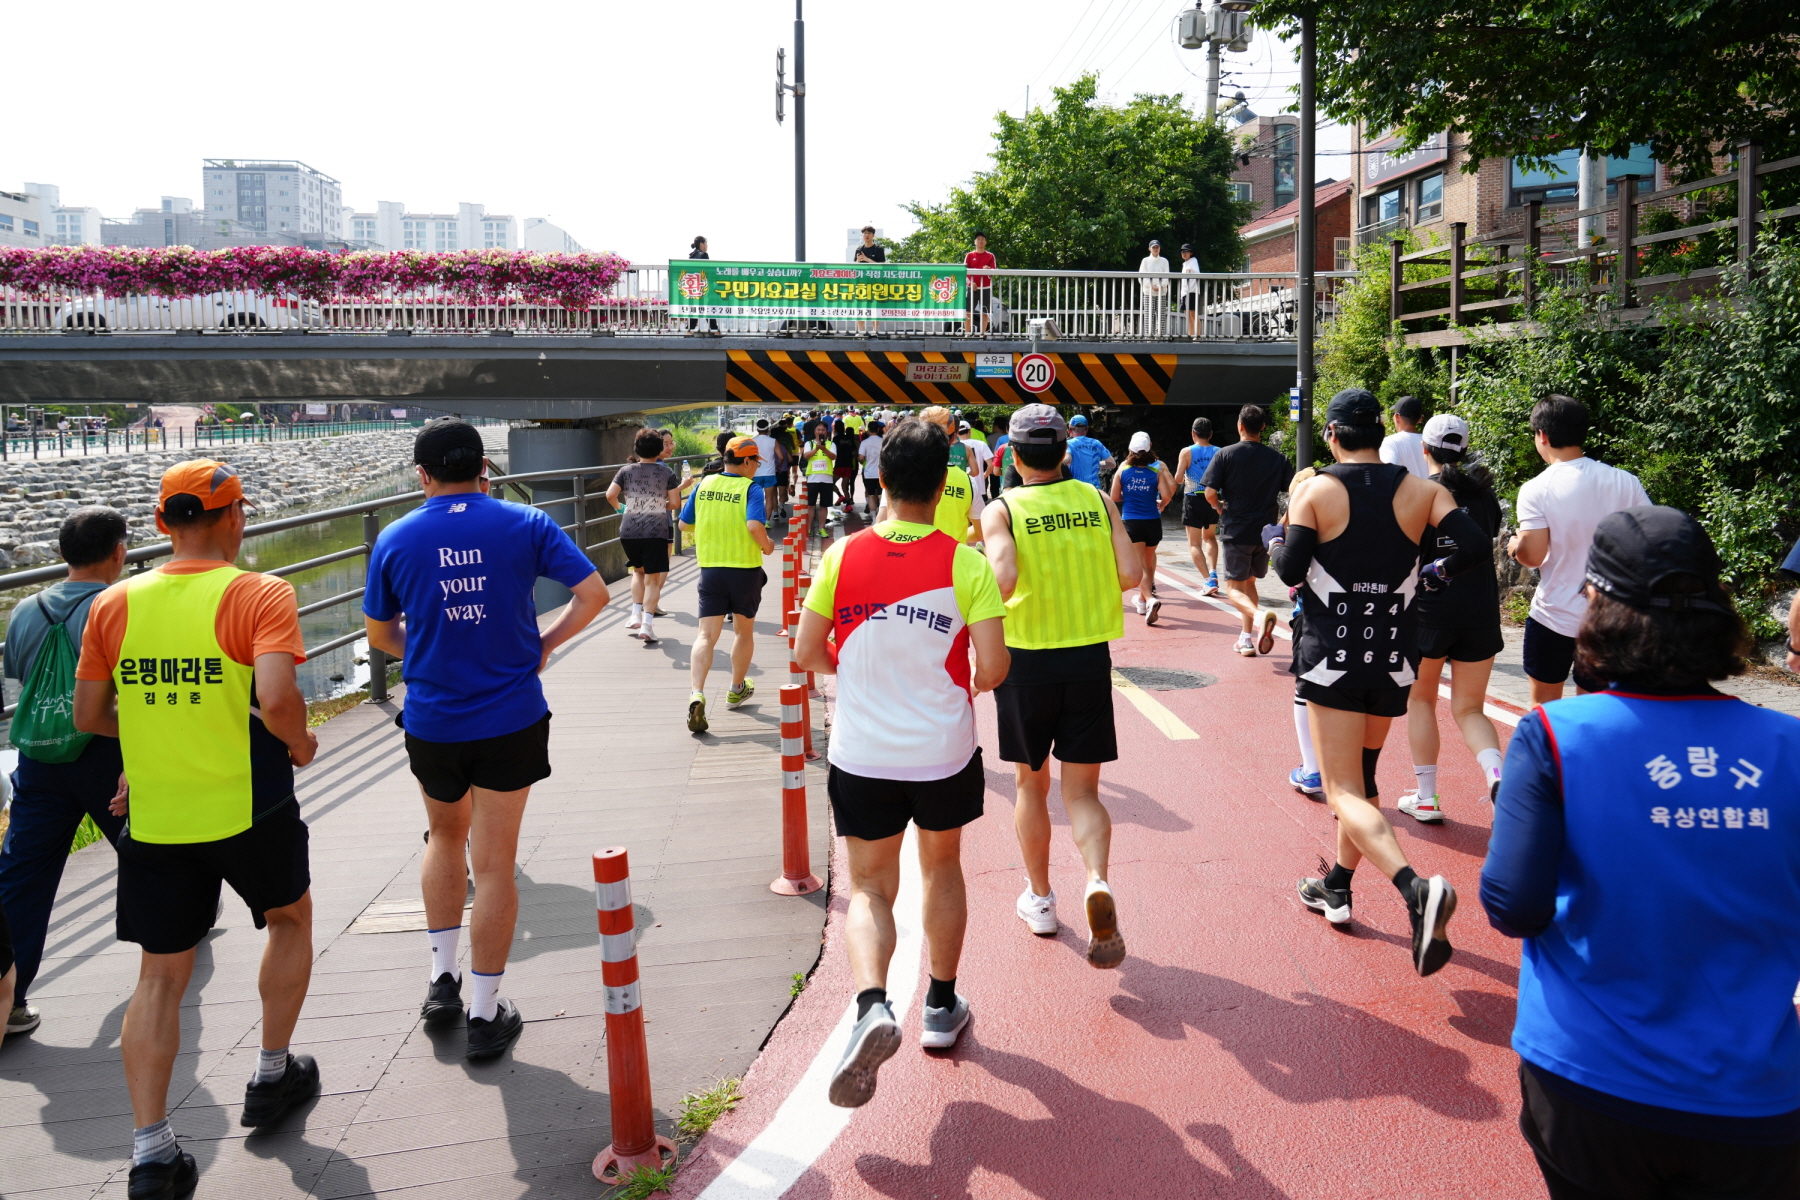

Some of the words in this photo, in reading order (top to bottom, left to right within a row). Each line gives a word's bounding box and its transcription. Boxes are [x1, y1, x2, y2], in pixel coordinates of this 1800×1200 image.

[716, 267, 739, 276] 노래를
[741, 268, 764, 276] 배우고
[767, 268, 802, 277] 싶습니까?
[866, 270, 880, 278] 직접
[883, 270, 922, 279] 지도합니다.
[683, 273, 705, 297] 환
[714, 280, 817, 300] 구민가요교실
[821, 282, 922, 302] 신규회원모집
[934, 276, 952, 300] 영
[915, 365, 960, 373] 머리조심
[982, 355, 1006, 365] 수유교
[1025, 364, 1046, 382] 20
[699, 490, 742, 504] 은평마라톤
[1025, 510, 1102, 535] 은평마라톤
[438, 547, 483, 568] Run
[439, 576, 487, 601] your
[444, 603, 487, 625] way.
[838, 603, 888, 625] 포이즈
[896, 604, 953, 634] 마라톤
[120, 658, 223, 686] 은평마라톤
[1644, 746, 1764, 790] 중랑구
[1650, 806, 1770, 830] 육상연합회
